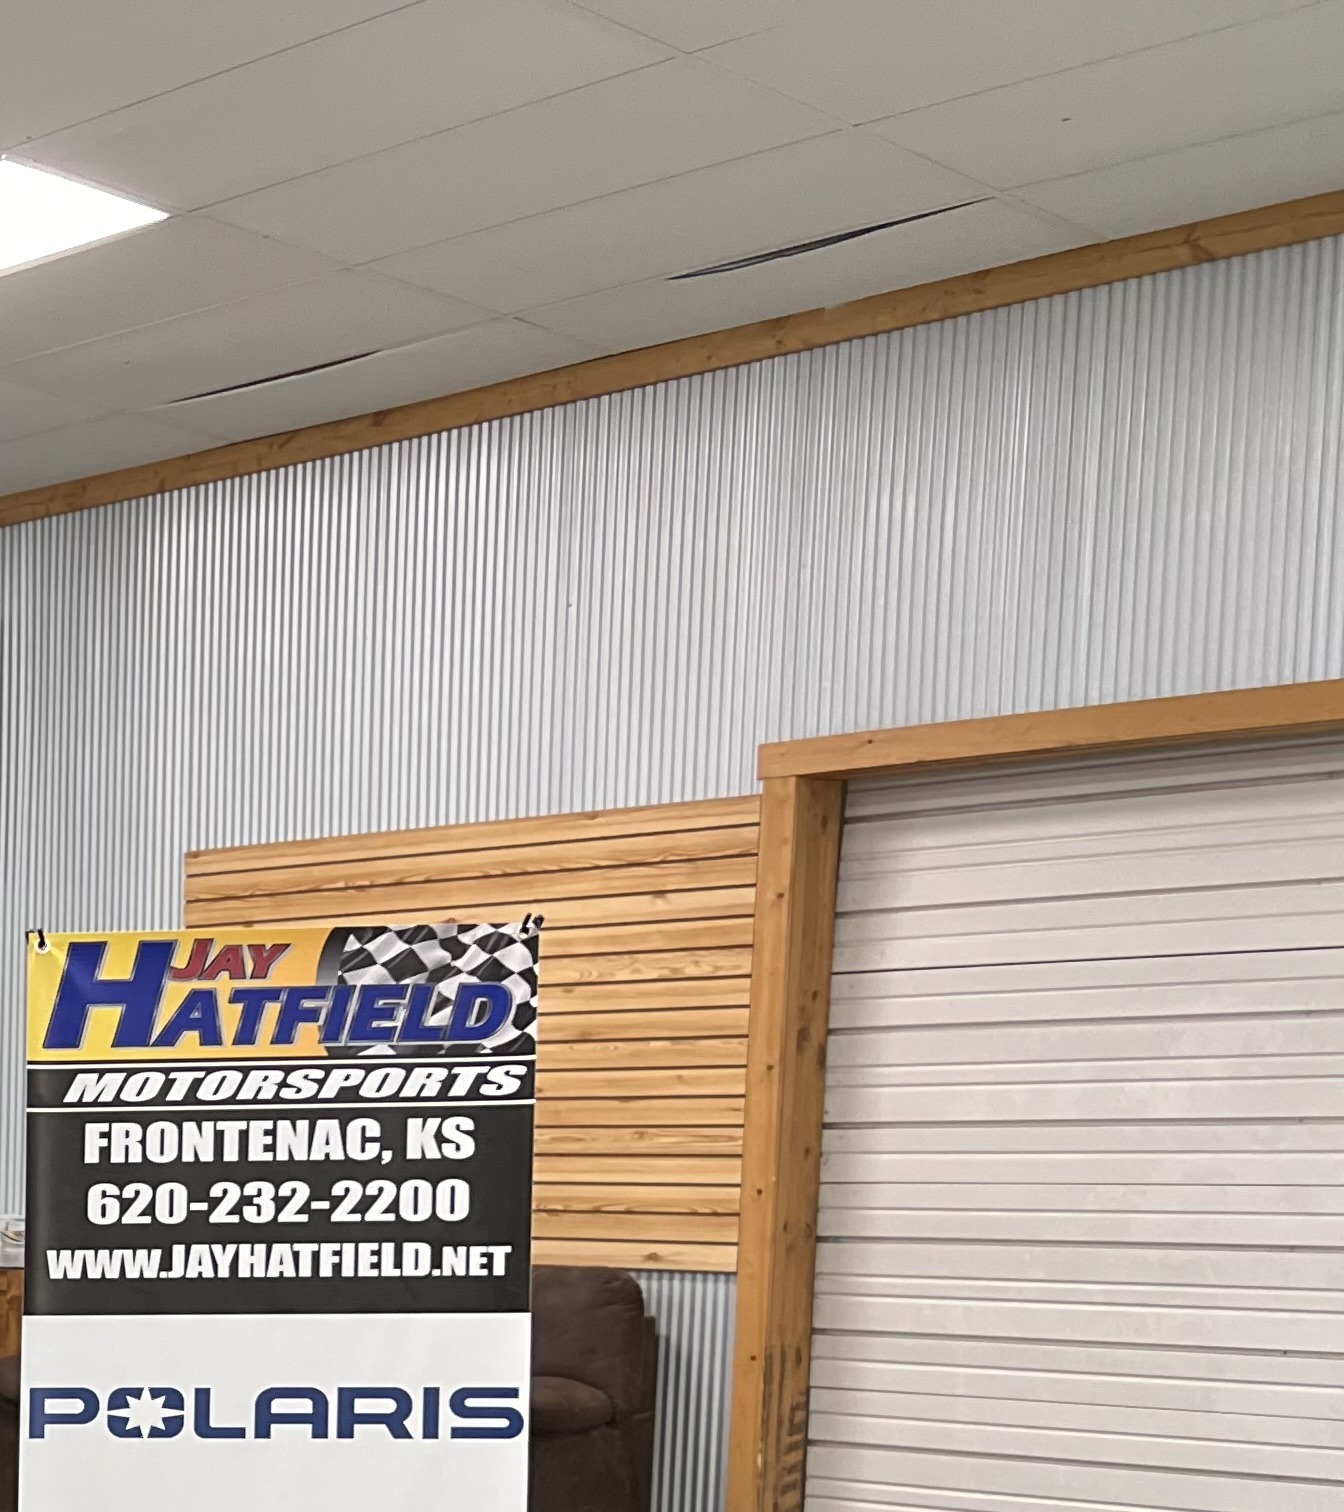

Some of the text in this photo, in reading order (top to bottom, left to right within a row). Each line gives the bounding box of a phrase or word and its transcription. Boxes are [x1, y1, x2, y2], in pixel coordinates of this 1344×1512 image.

[171, 937, 296, 982] JAY
[42, 938, 514, 1050] HATFIELD
[62, 1064, 529, 1104] MOTORSPORTS
[83, 1115, 477, 1165] FRONTENAC, KS
[85, 1178, 472, 1226] 620-232-2200
[45, 1242, 513, 1281] WWW.JAYHATFIELD.NET
[27, 1385, 525, 1440] POLARIS
